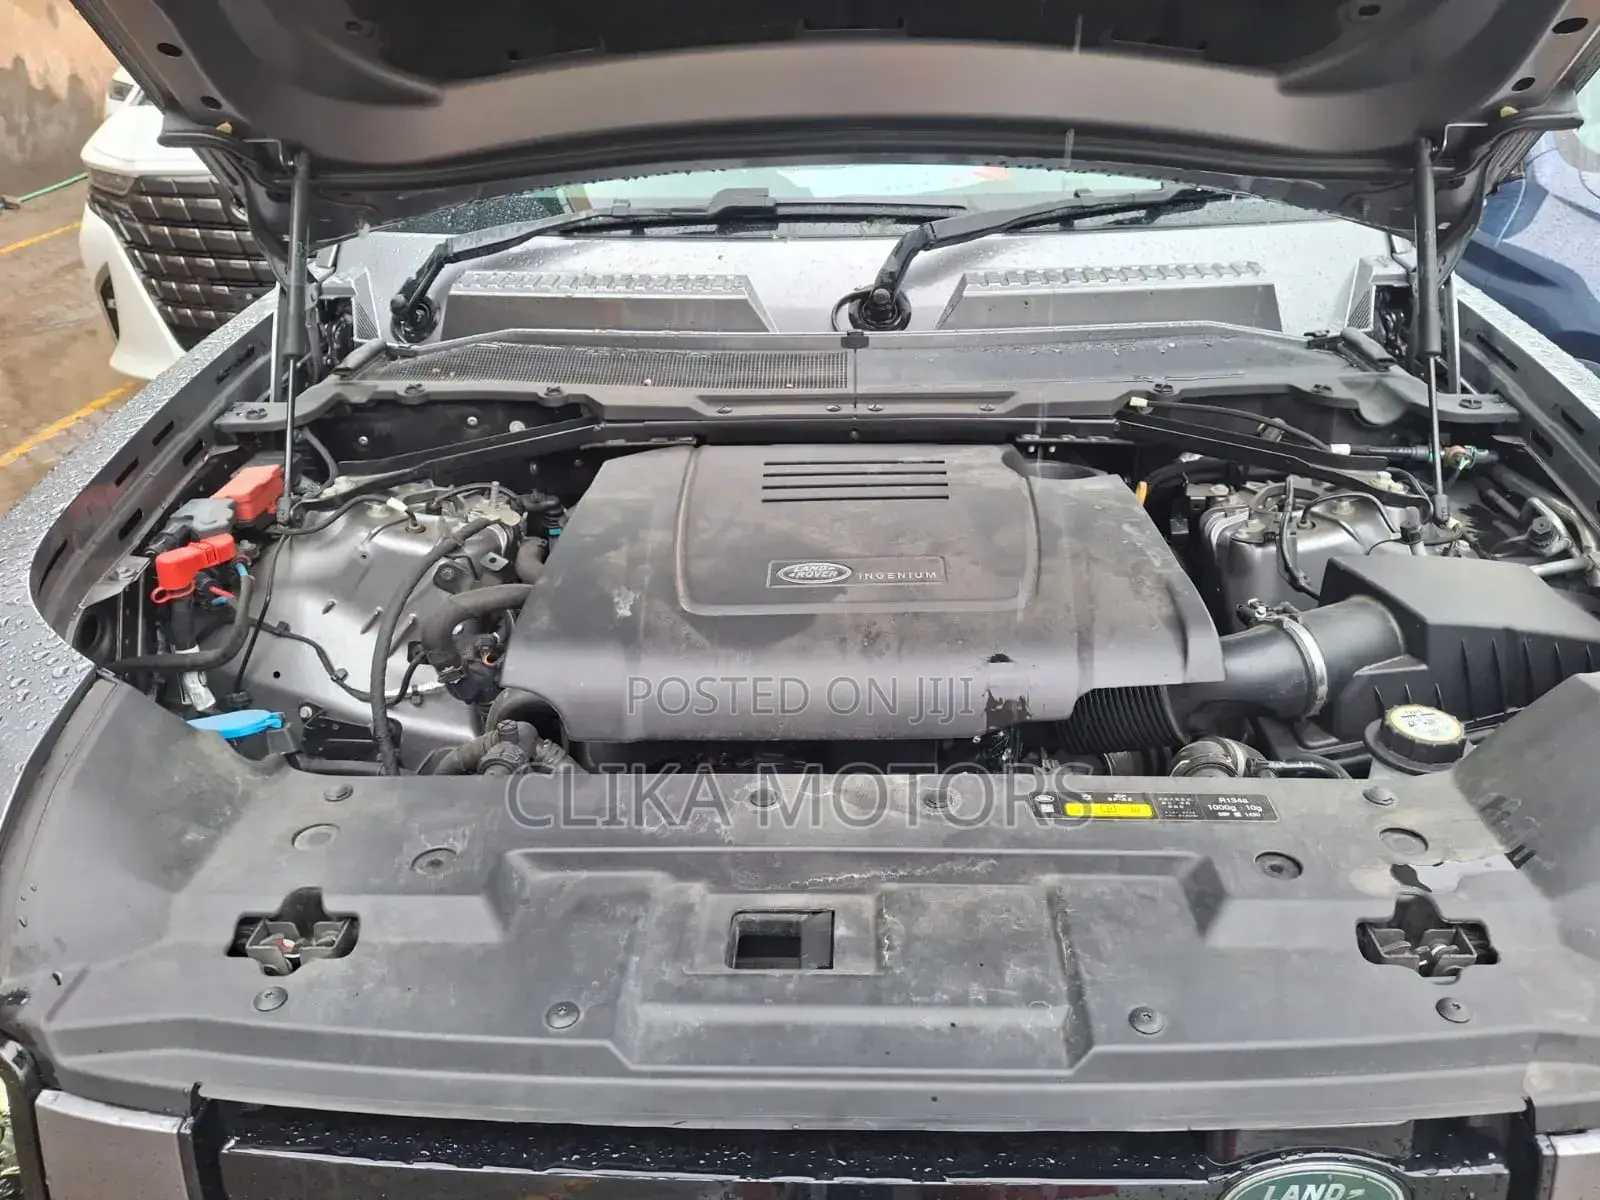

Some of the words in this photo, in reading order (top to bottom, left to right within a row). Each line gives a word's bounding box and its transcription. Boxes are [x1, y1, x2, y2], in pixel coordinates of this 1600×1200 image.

[794, 565, 828, 573] LAND
[796, 570, 839, 578] ROVER
[859, 571, 937, 580] INGENIUM
[1262, 1183, 1346, 1200] LAND
